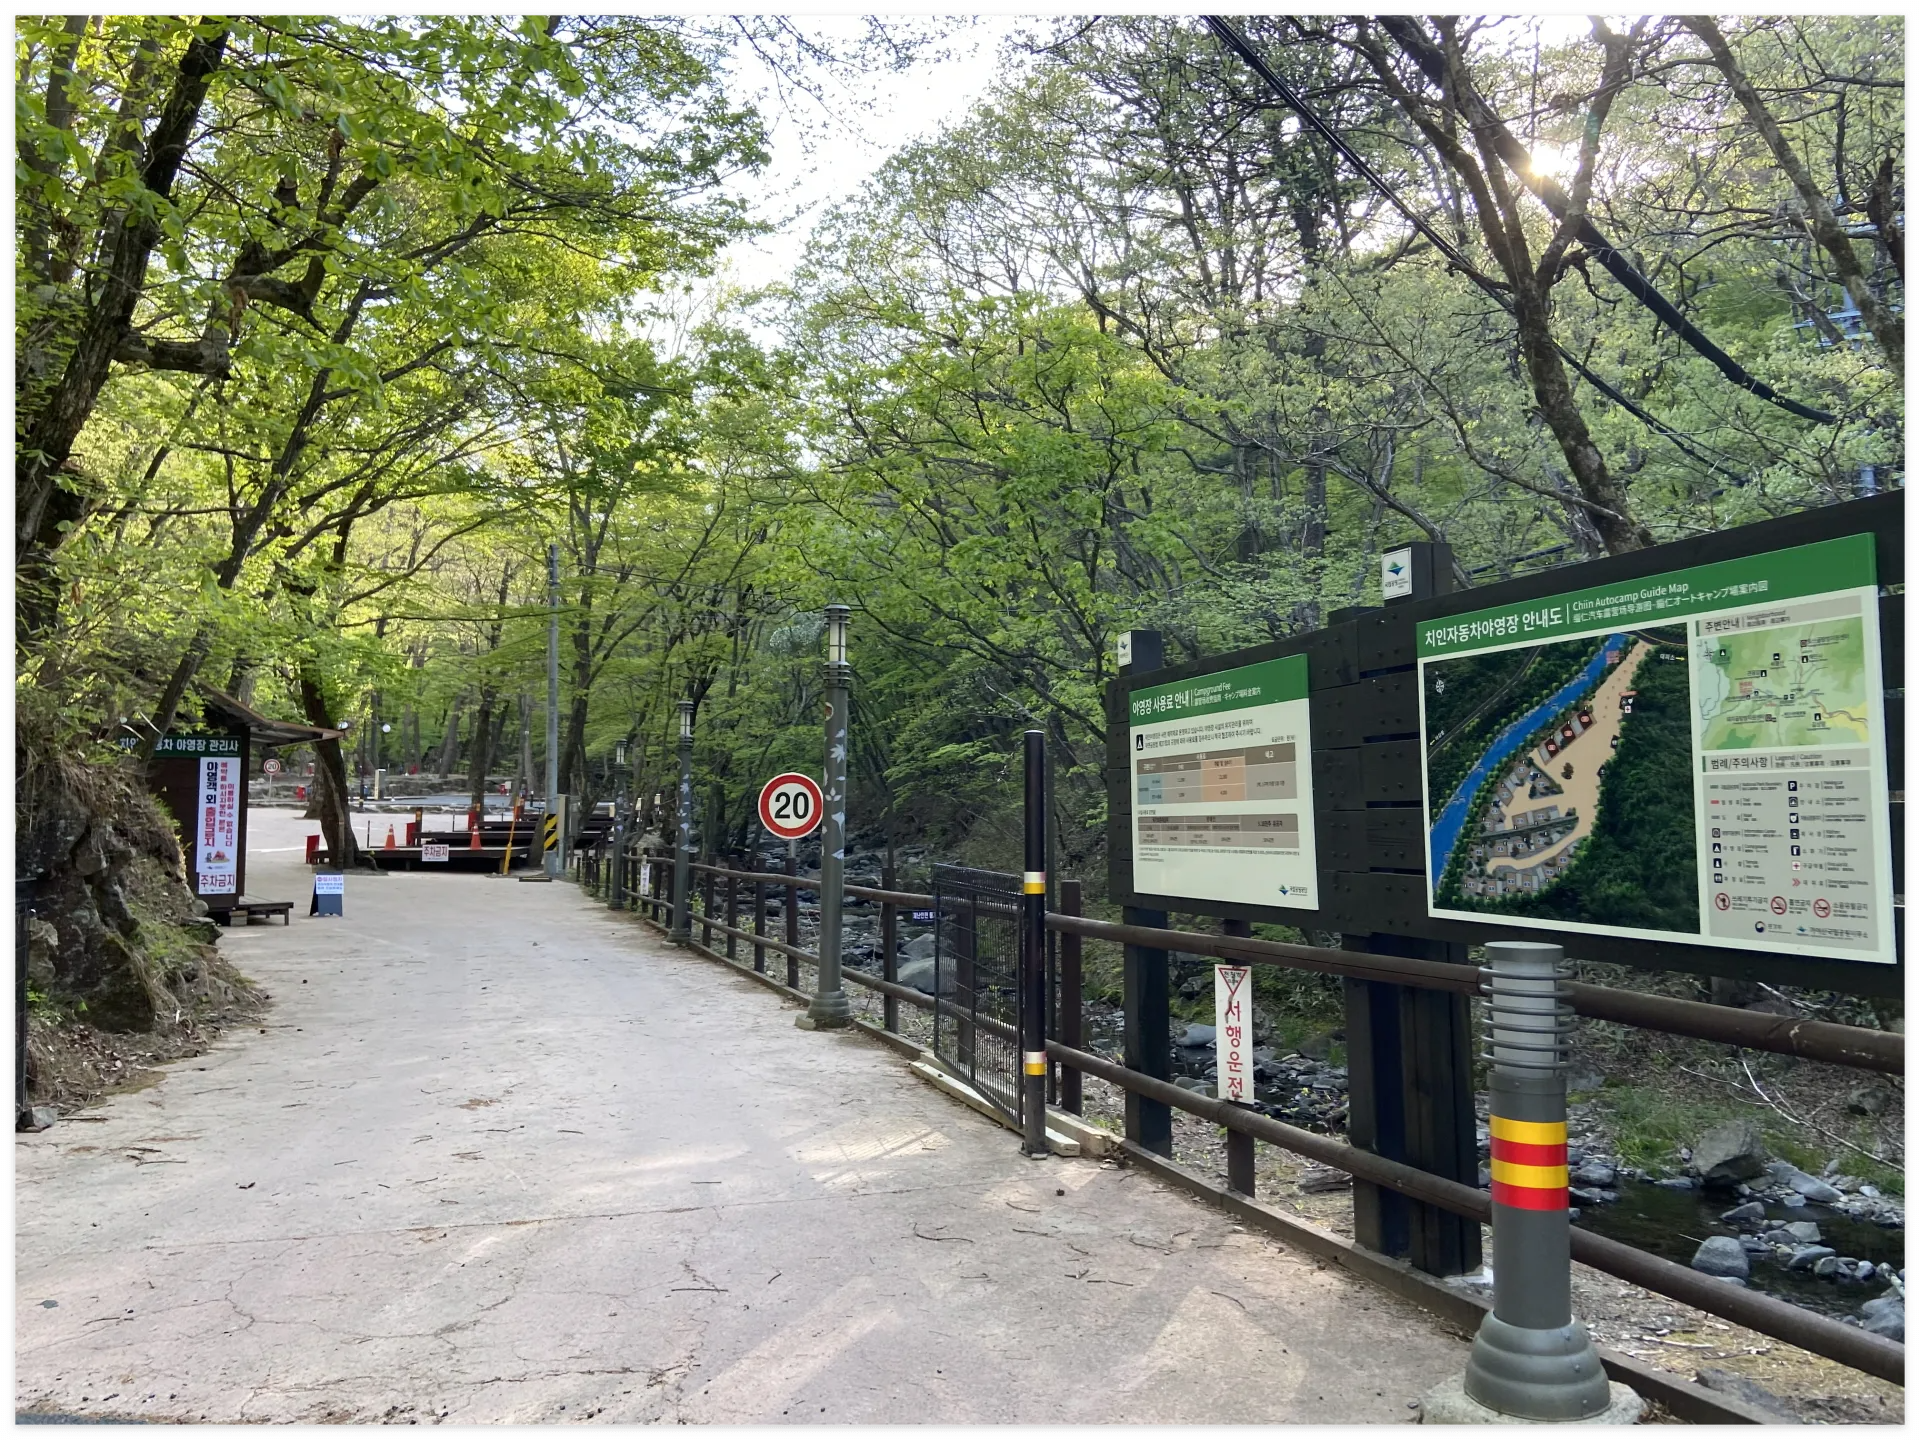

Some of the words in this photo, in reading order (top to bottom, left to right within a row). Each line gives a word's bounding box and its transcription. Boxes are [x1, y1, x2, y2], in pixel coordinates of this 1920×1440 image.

[1572, 600, 1594, 611] Chiin
[1595, 592, 1639, 608] Autocamp
[1640, 585, 1667, 599] Guide
[1668, 582, 1689, 595] Map
[1425, 614, 1519, 647] 치인자동차야영장
[1522, 607, 1563, 632] 안내도
[1705, 617, 1740, 632] 주변안내
[1132, 698, 1152, 717] 야영장
[1153, 696, 1173, 713] 사용료
[1174, 690, 1190, 710] 안내
[176, 739, 207, 752] 야영장
[209, 739, 239, 752] 관리사
[267, 762, 276, 770] 20
[1711, 757, 1768, 770] 범례/주의사항
[206, 761, 218, 792] 야영객
[206, 794, 216, 804] 외
[774, 791, 809, 819] 20
[204, 807, 216, 847] 출입금지
[423, 846, 448, 857] 주차금지
[200, 874, 235, 887] 주차금지
[1225, 1000, 1244, 1099] 서행운전
